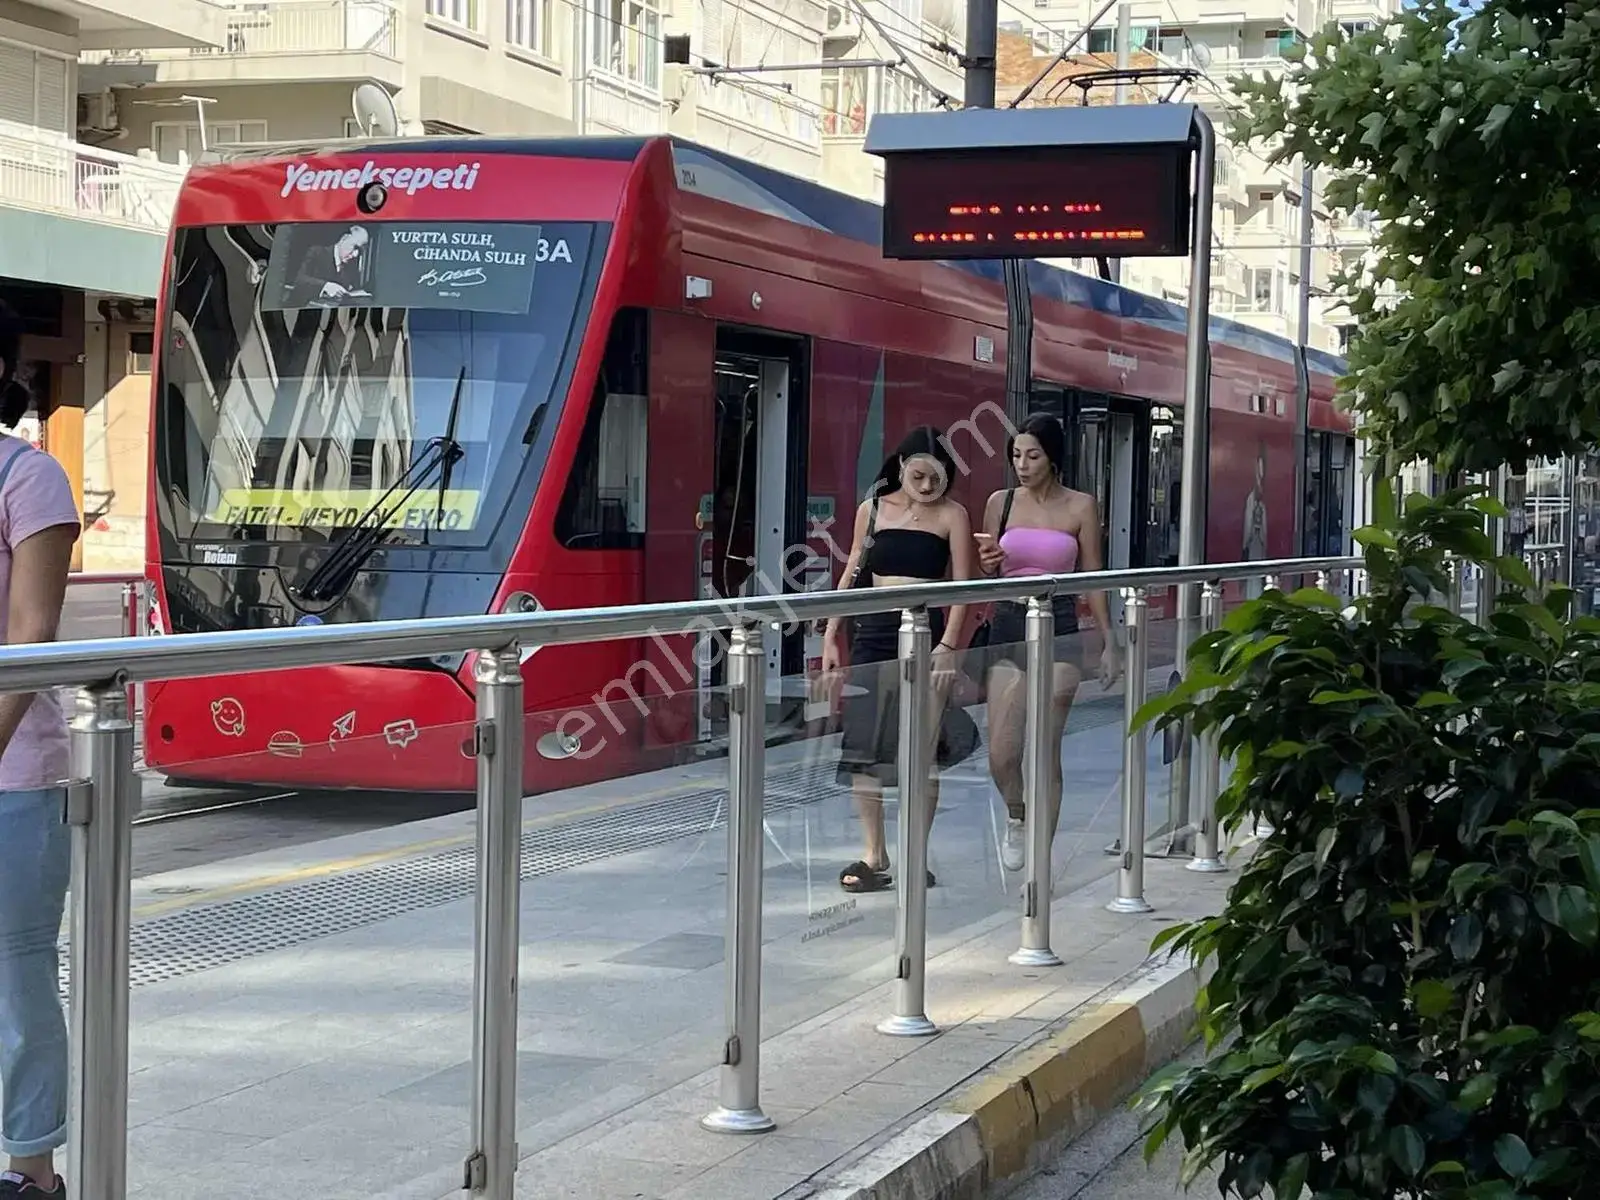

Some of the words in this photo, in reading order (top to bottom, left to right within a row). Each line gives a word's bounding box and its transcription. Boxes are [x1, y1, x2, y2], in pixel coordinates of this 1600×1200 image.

[280, 160, 480, 198] Yemeksepeti
[392, 231, 448, 244] YURTTA
[451, 232, 496, 248] SULH,
[413, 245, 481, 263] CİHANDA
[484, 250, 527, 266] SULH
[404, 508, 462, 530] EXPO
